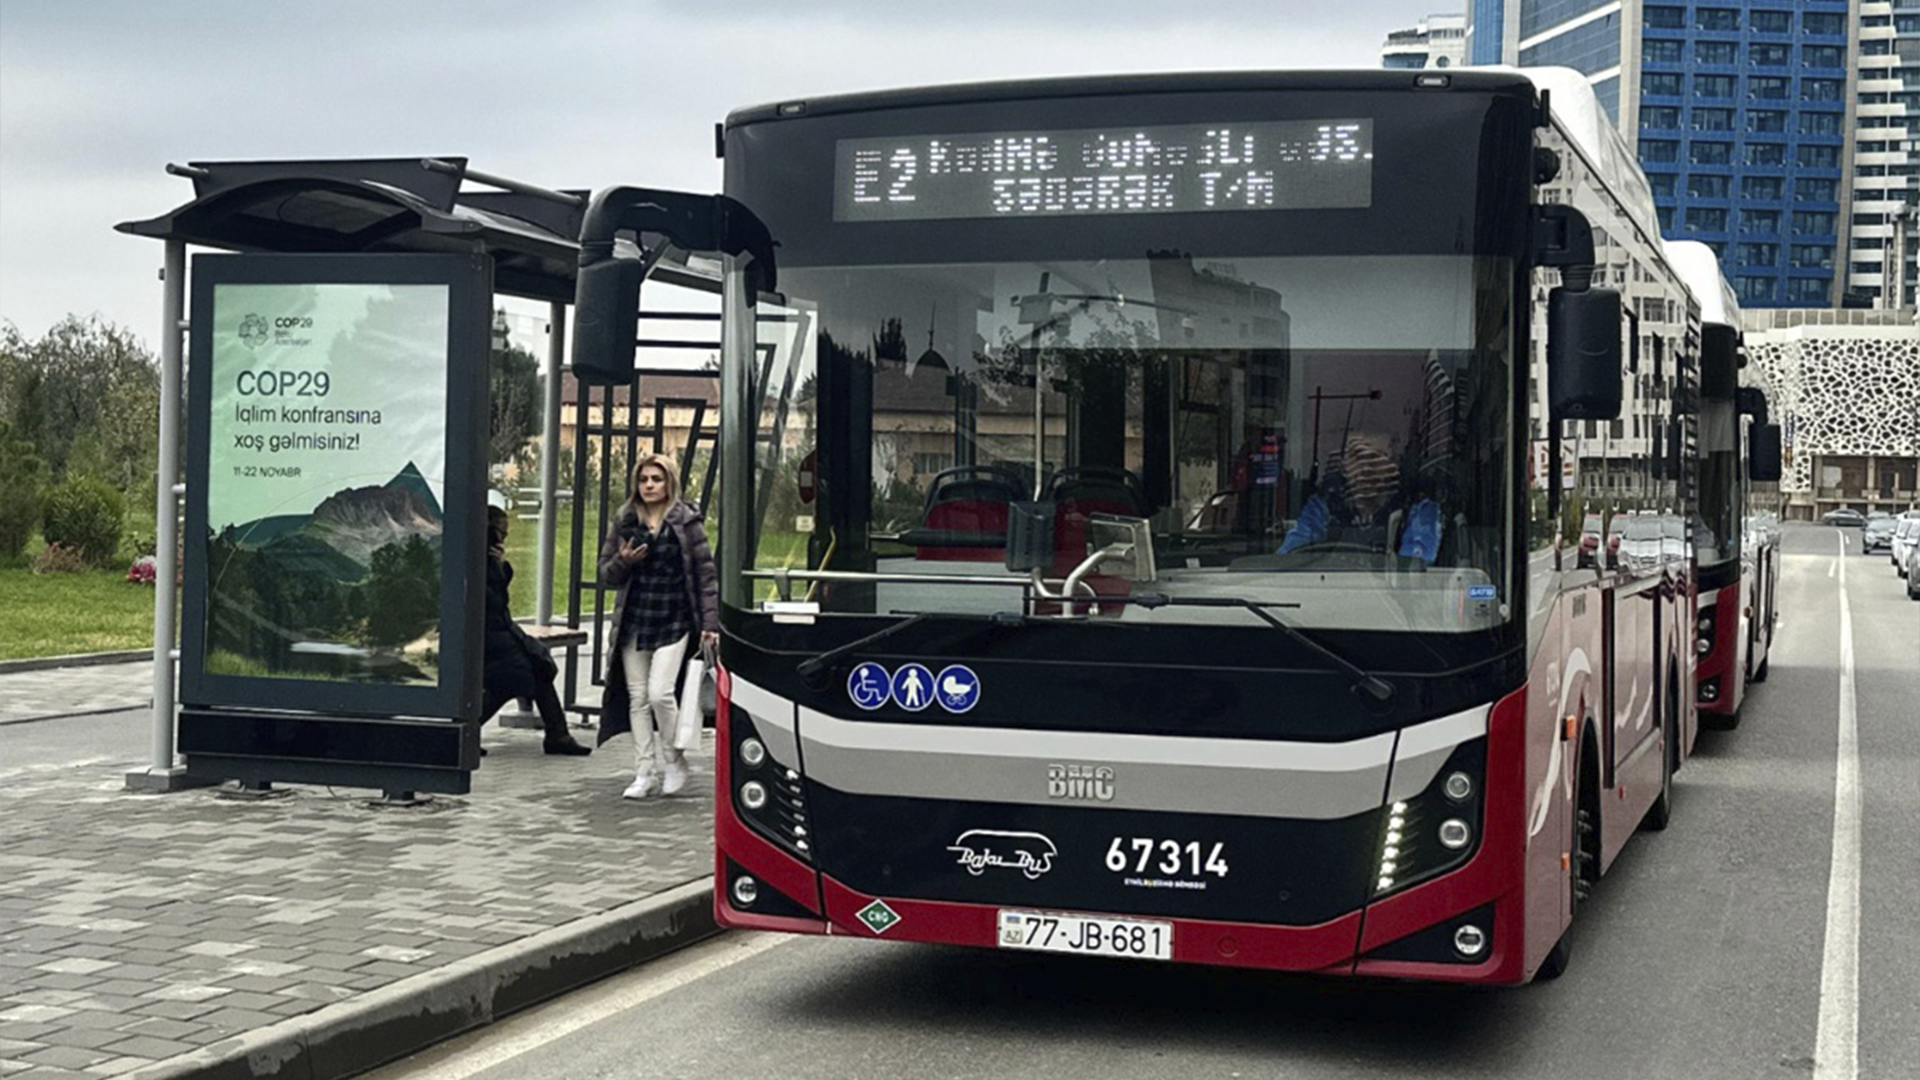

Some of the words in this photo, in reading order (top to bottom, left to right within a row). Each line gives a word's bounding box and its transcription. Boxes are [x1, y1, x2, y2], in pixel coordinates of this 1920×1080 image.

[852, 147, 917, 201] E2
[274, 316, 313, 328] COP29
[236, 370, 331, 396] COP29
[280, 405, 382, 424] konfransına
[233, 434, 264, 451] xoş
[269, 432, 360, 452] gəlmisiniz!
[233, 466, 257, 476] 11-22
[260, 466, 301, 477] NOYABR
[1048, 763, 1114, 801] BMC
[1105, 837, 1229, 877] 67314
[867, 910, 889, 923] CNG
[1005, 930, 1020, 941] AZ
[1025, 917, 1161, 956] 77-JB-681
